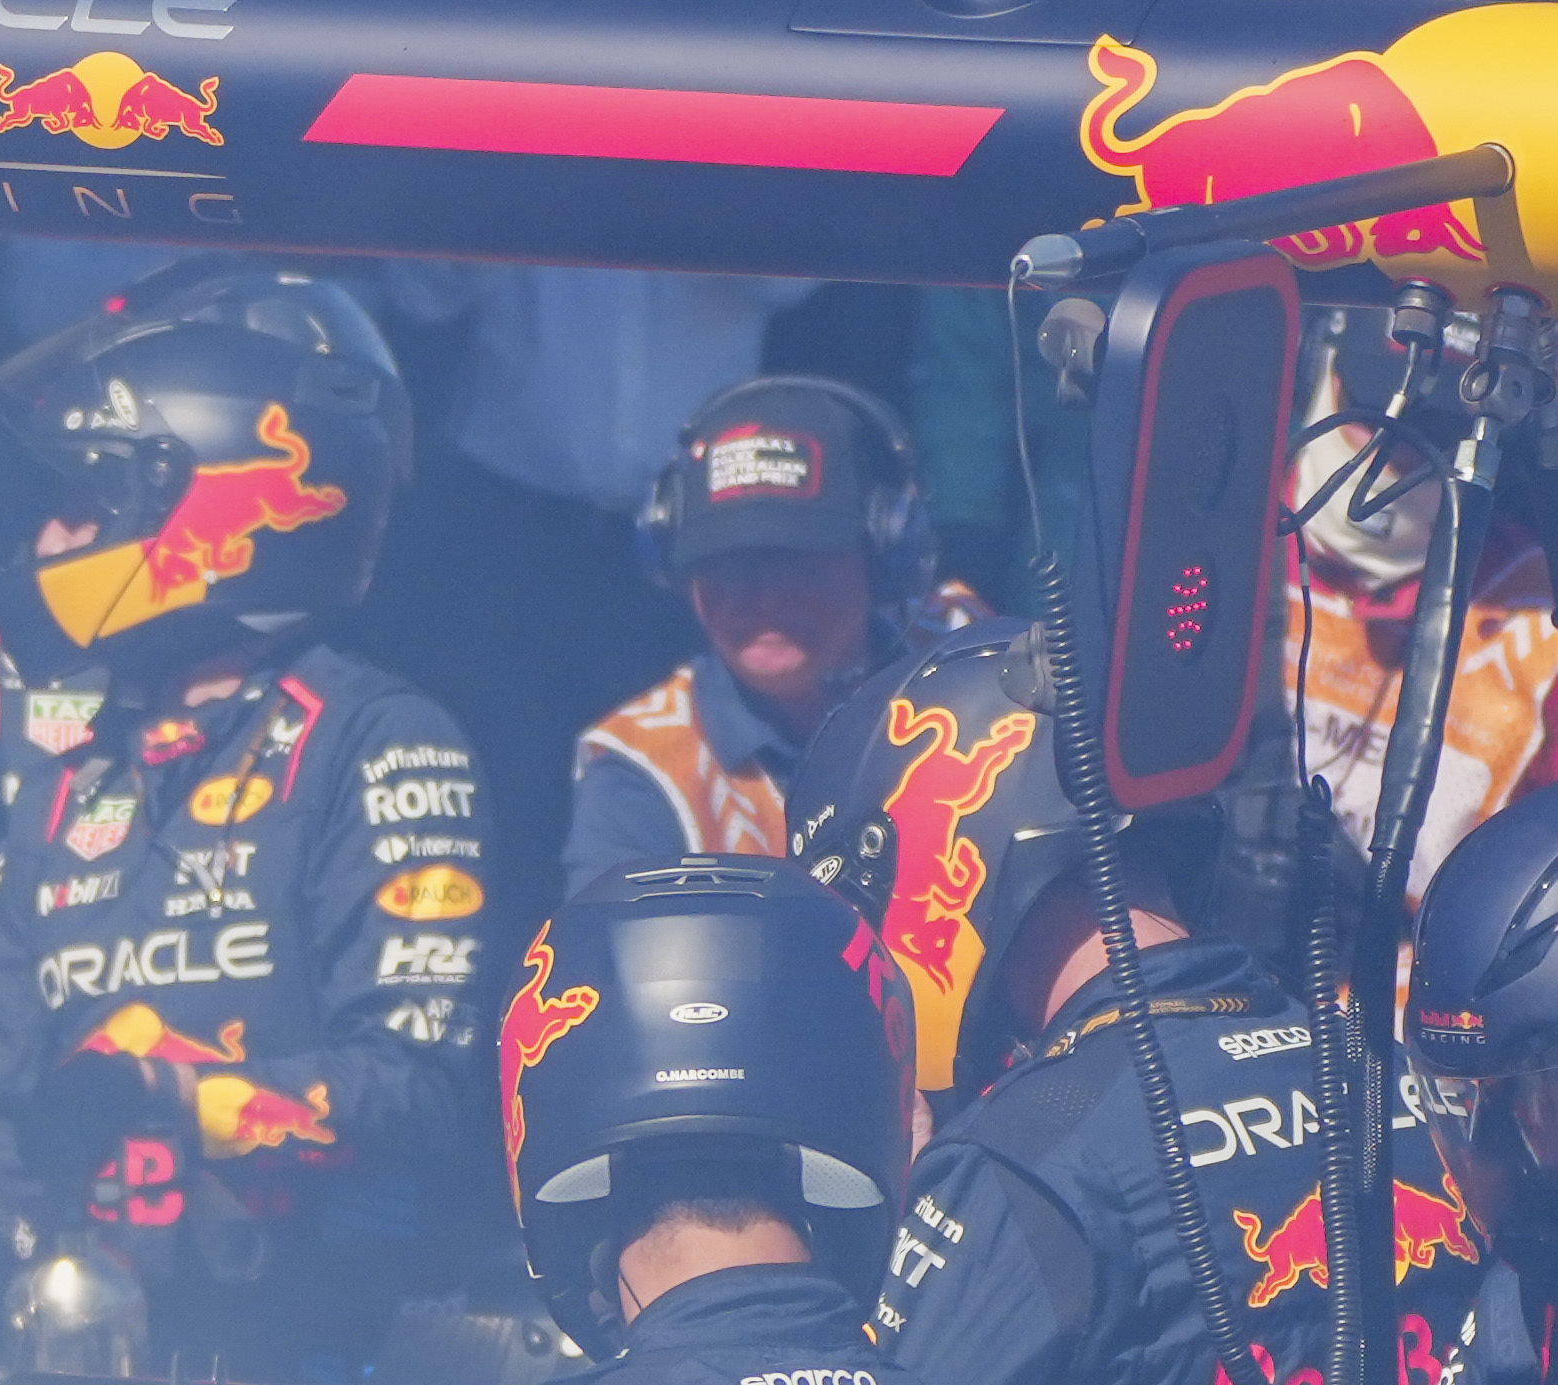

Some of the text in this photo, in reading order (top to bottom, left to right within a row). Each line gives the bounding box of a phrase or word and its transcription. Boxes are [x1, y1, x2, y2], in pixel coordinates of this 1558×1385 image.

[364, 779, 475, 826] ROKT
[37, 922, 276, 1010] ORACLE
[681, 1007, 717, 1019] HJC
[1218, 1025, 1312, 1061] sparco
[655, 1069, 745, 1082] O.HARCOMBE
